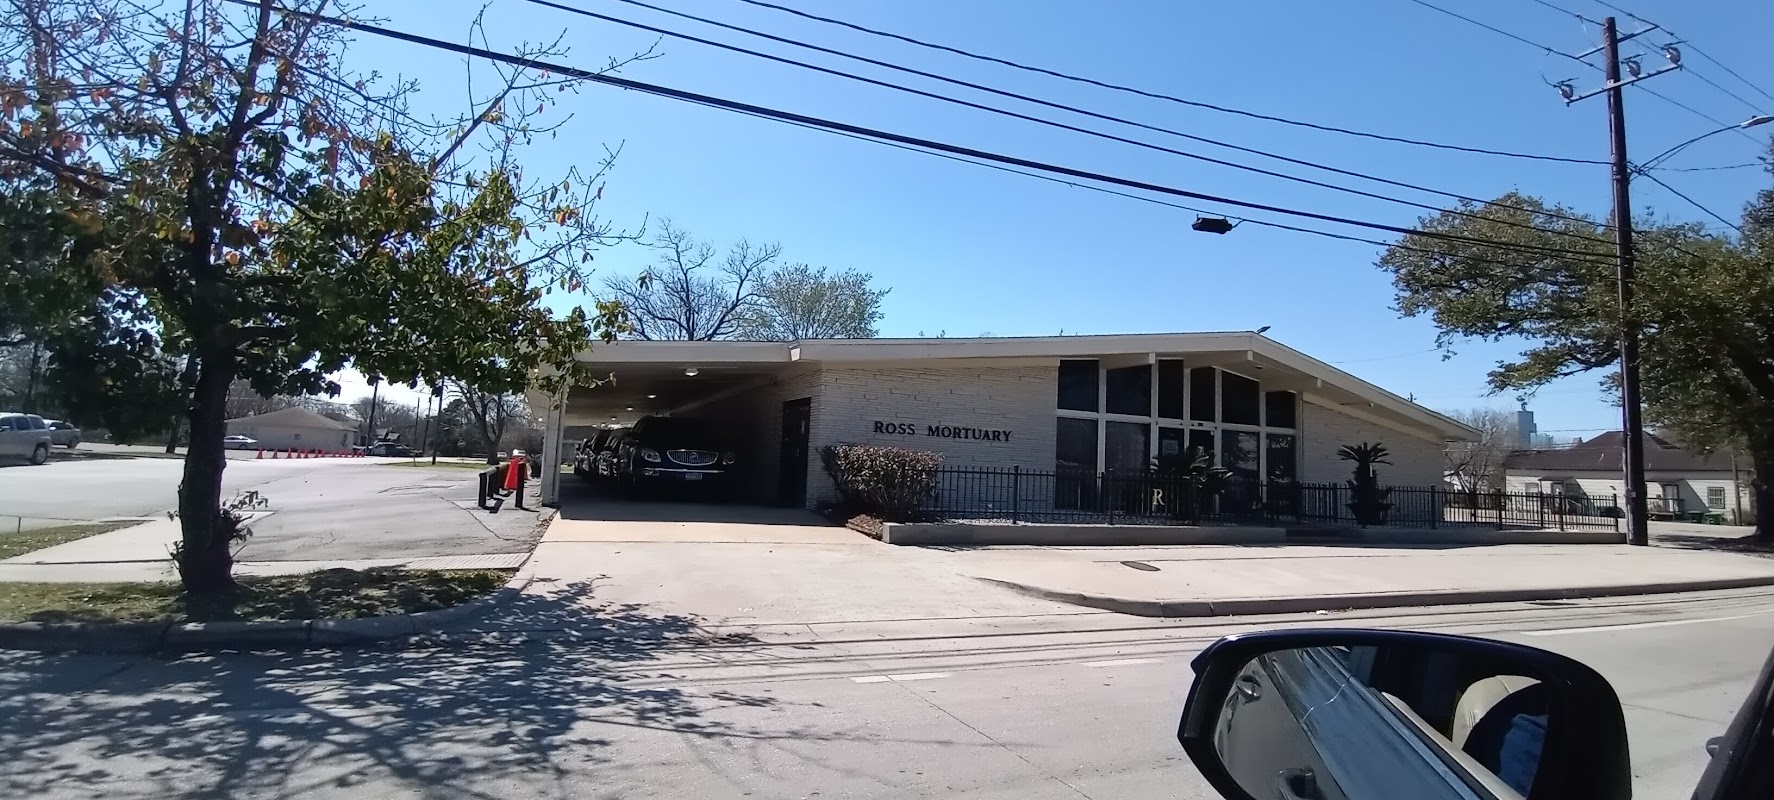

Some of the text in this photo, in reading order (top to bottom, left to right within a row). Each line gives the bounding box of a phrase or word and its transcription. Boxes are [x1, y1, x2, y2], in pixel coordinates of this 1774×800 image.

[873, 420, 1012, 442] ROSS MORTUARY
[1152, 488, 1165, 505] R
